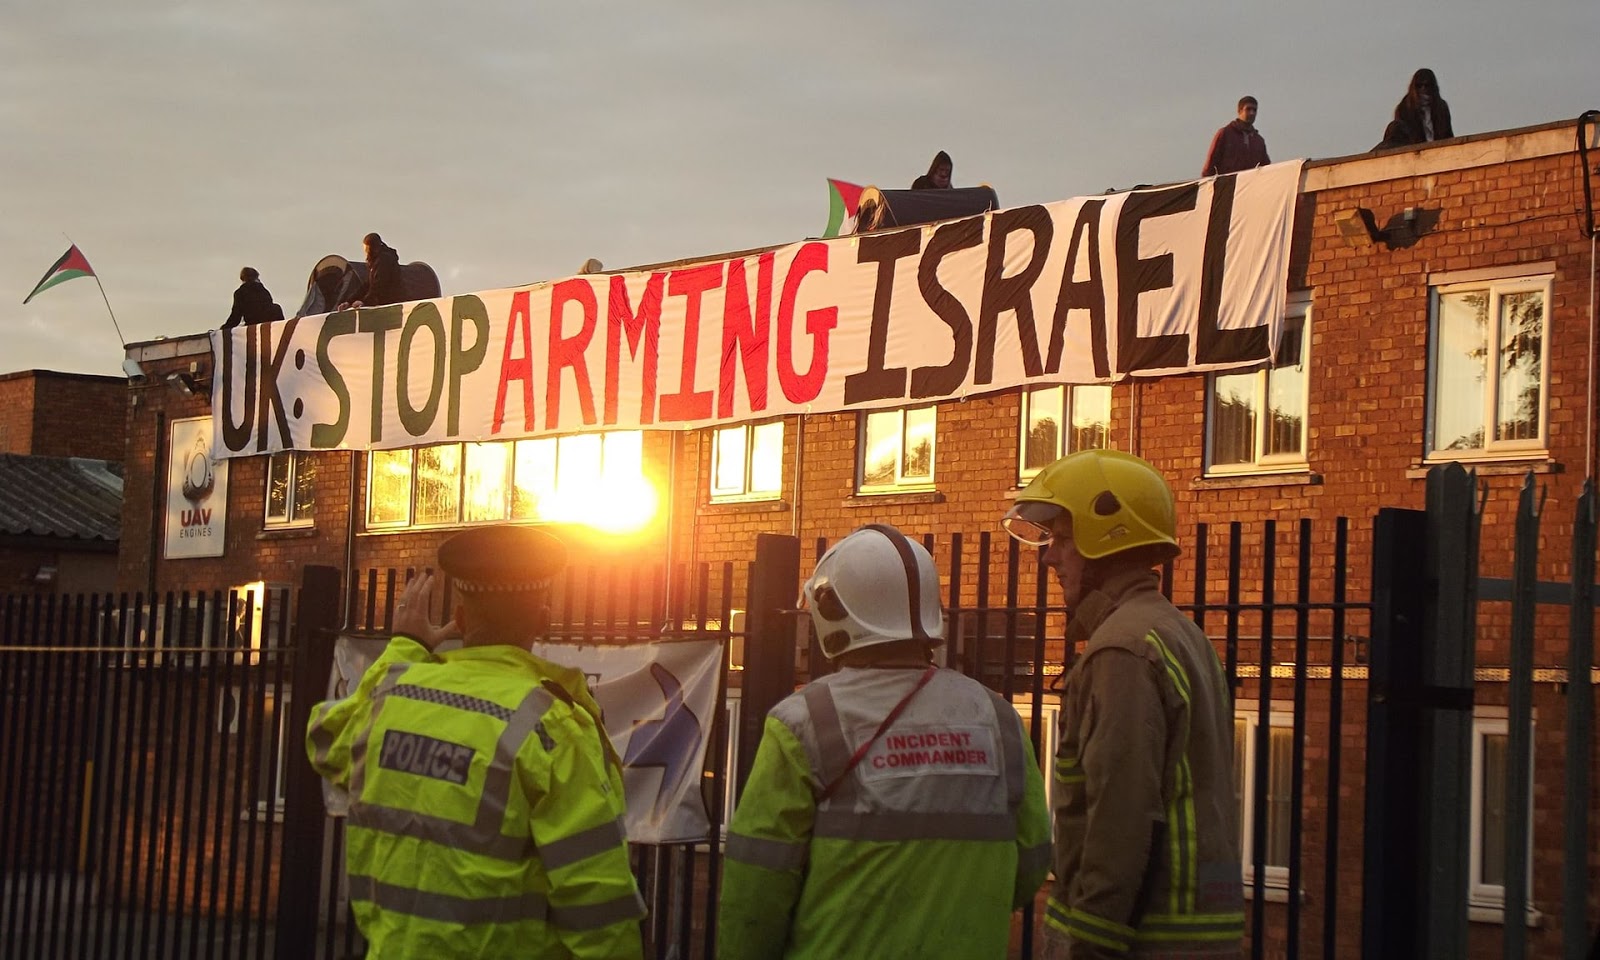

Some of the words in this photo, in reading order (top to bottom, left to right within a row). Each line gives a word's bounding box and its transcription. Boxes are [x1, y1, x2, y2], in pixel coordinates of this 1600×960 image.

[222, 318, 305, 452] UK:
[311, 294, 490, 448] STOP
[491, 242, 838, 434] ARMING
[844, 174, 1271, 406] ISRAEL
[181, 508, 212, 528] UAV
[180, 527, 212, 538] ENGINES
[886, 732, 972, 750] INCIDENT
[381, 733, 471, 782] POLICE
[873, 750, 987, 768] COMMANDER
